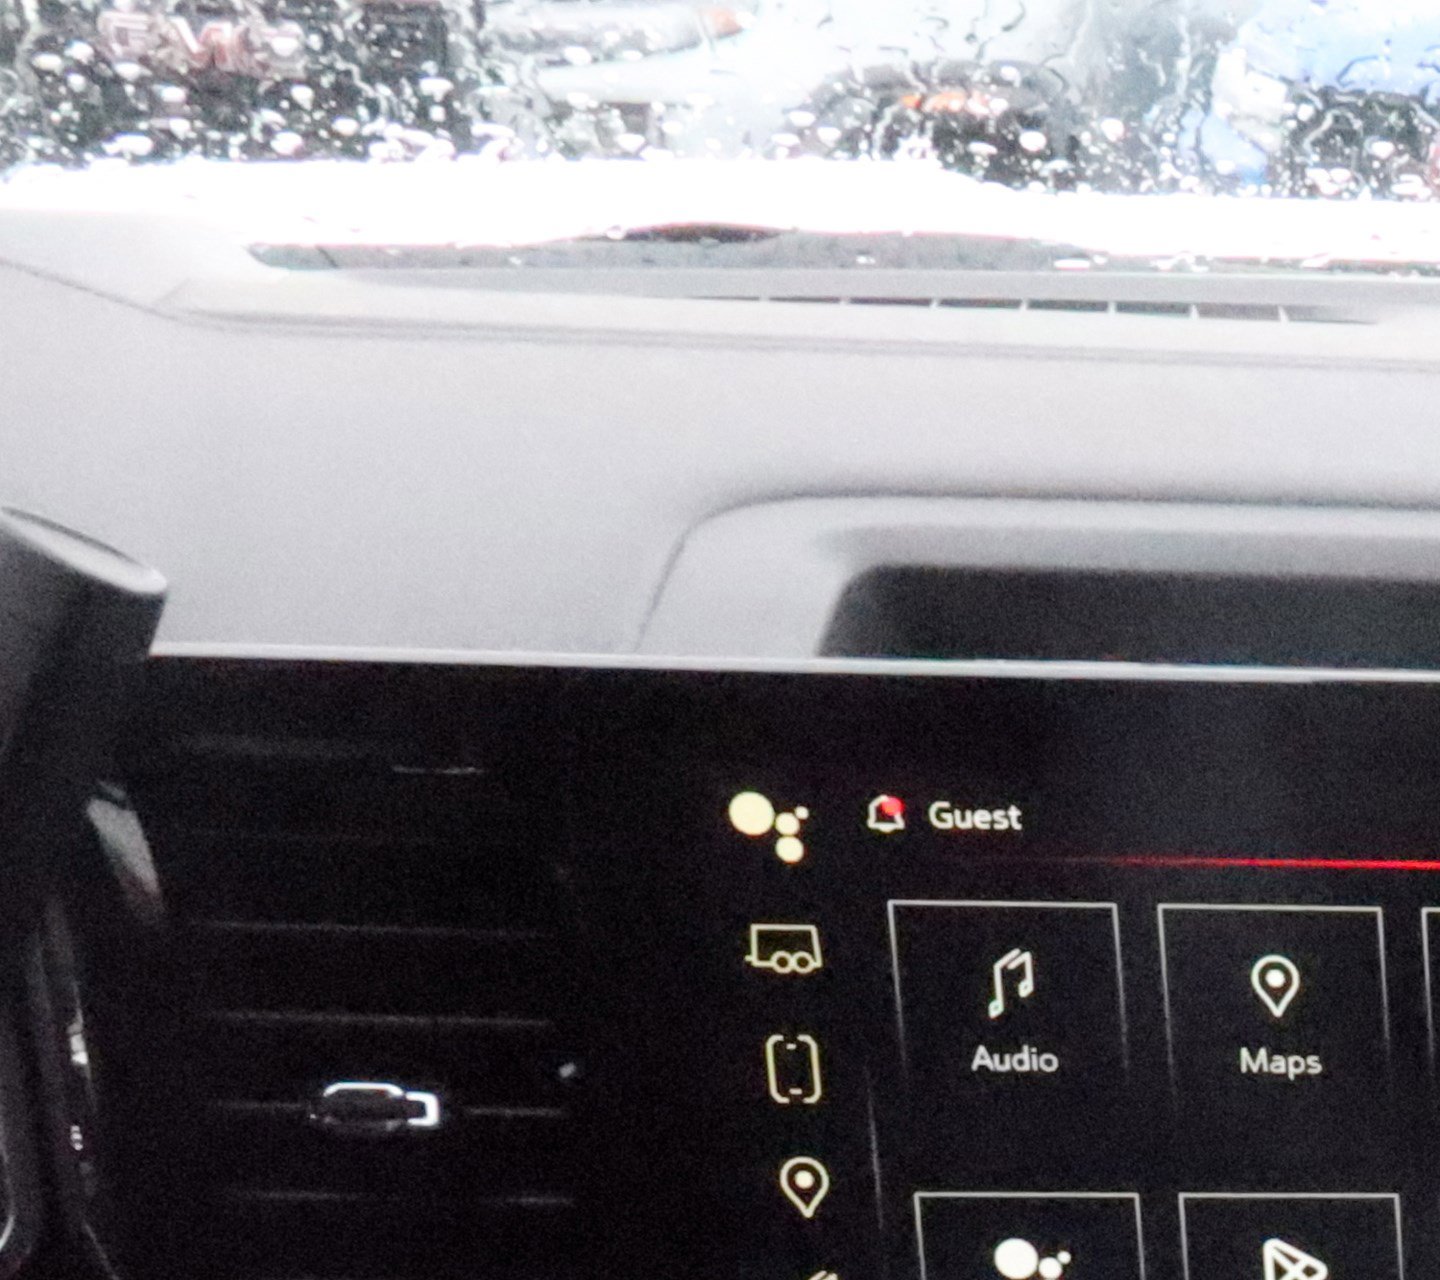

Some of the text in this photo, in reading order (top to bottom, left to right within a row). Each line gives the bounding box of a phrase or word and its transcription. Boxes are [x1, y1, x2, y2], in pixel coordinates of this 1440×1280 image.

[928, 801, 1023, 832] Guest
[971, 1044, 1059, 1075] Audio
[1238, 1046, 1323, 1080] Maps
